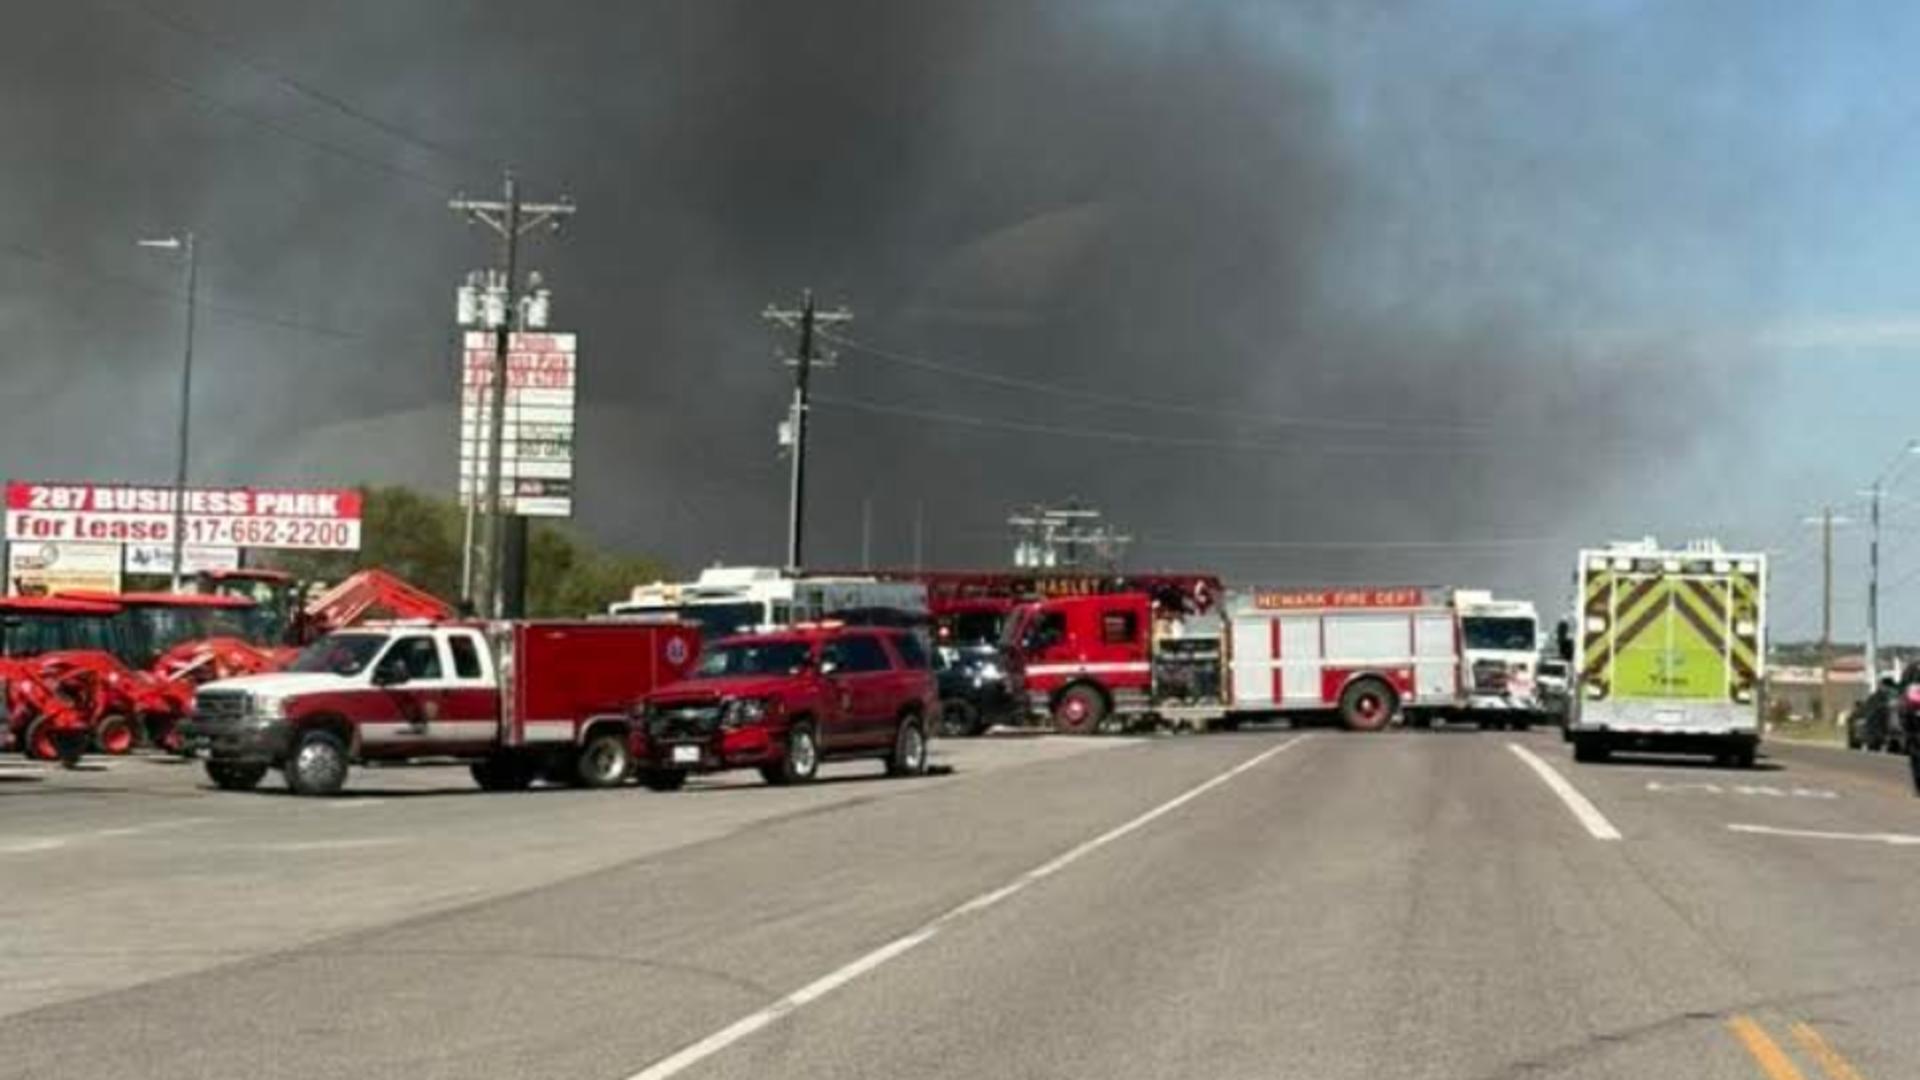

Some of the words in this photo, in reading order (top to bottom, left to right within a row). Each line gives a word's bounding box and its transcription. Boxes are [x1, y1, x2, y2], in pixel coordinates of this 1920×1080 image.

[30, 487, 86, 510] 287
[255, 492, 338, 516] PARK
[16, 515, 66, 538] For
[74, 516, 168, 540] Lease
[1333, 589, 1367, 606] FIRE
